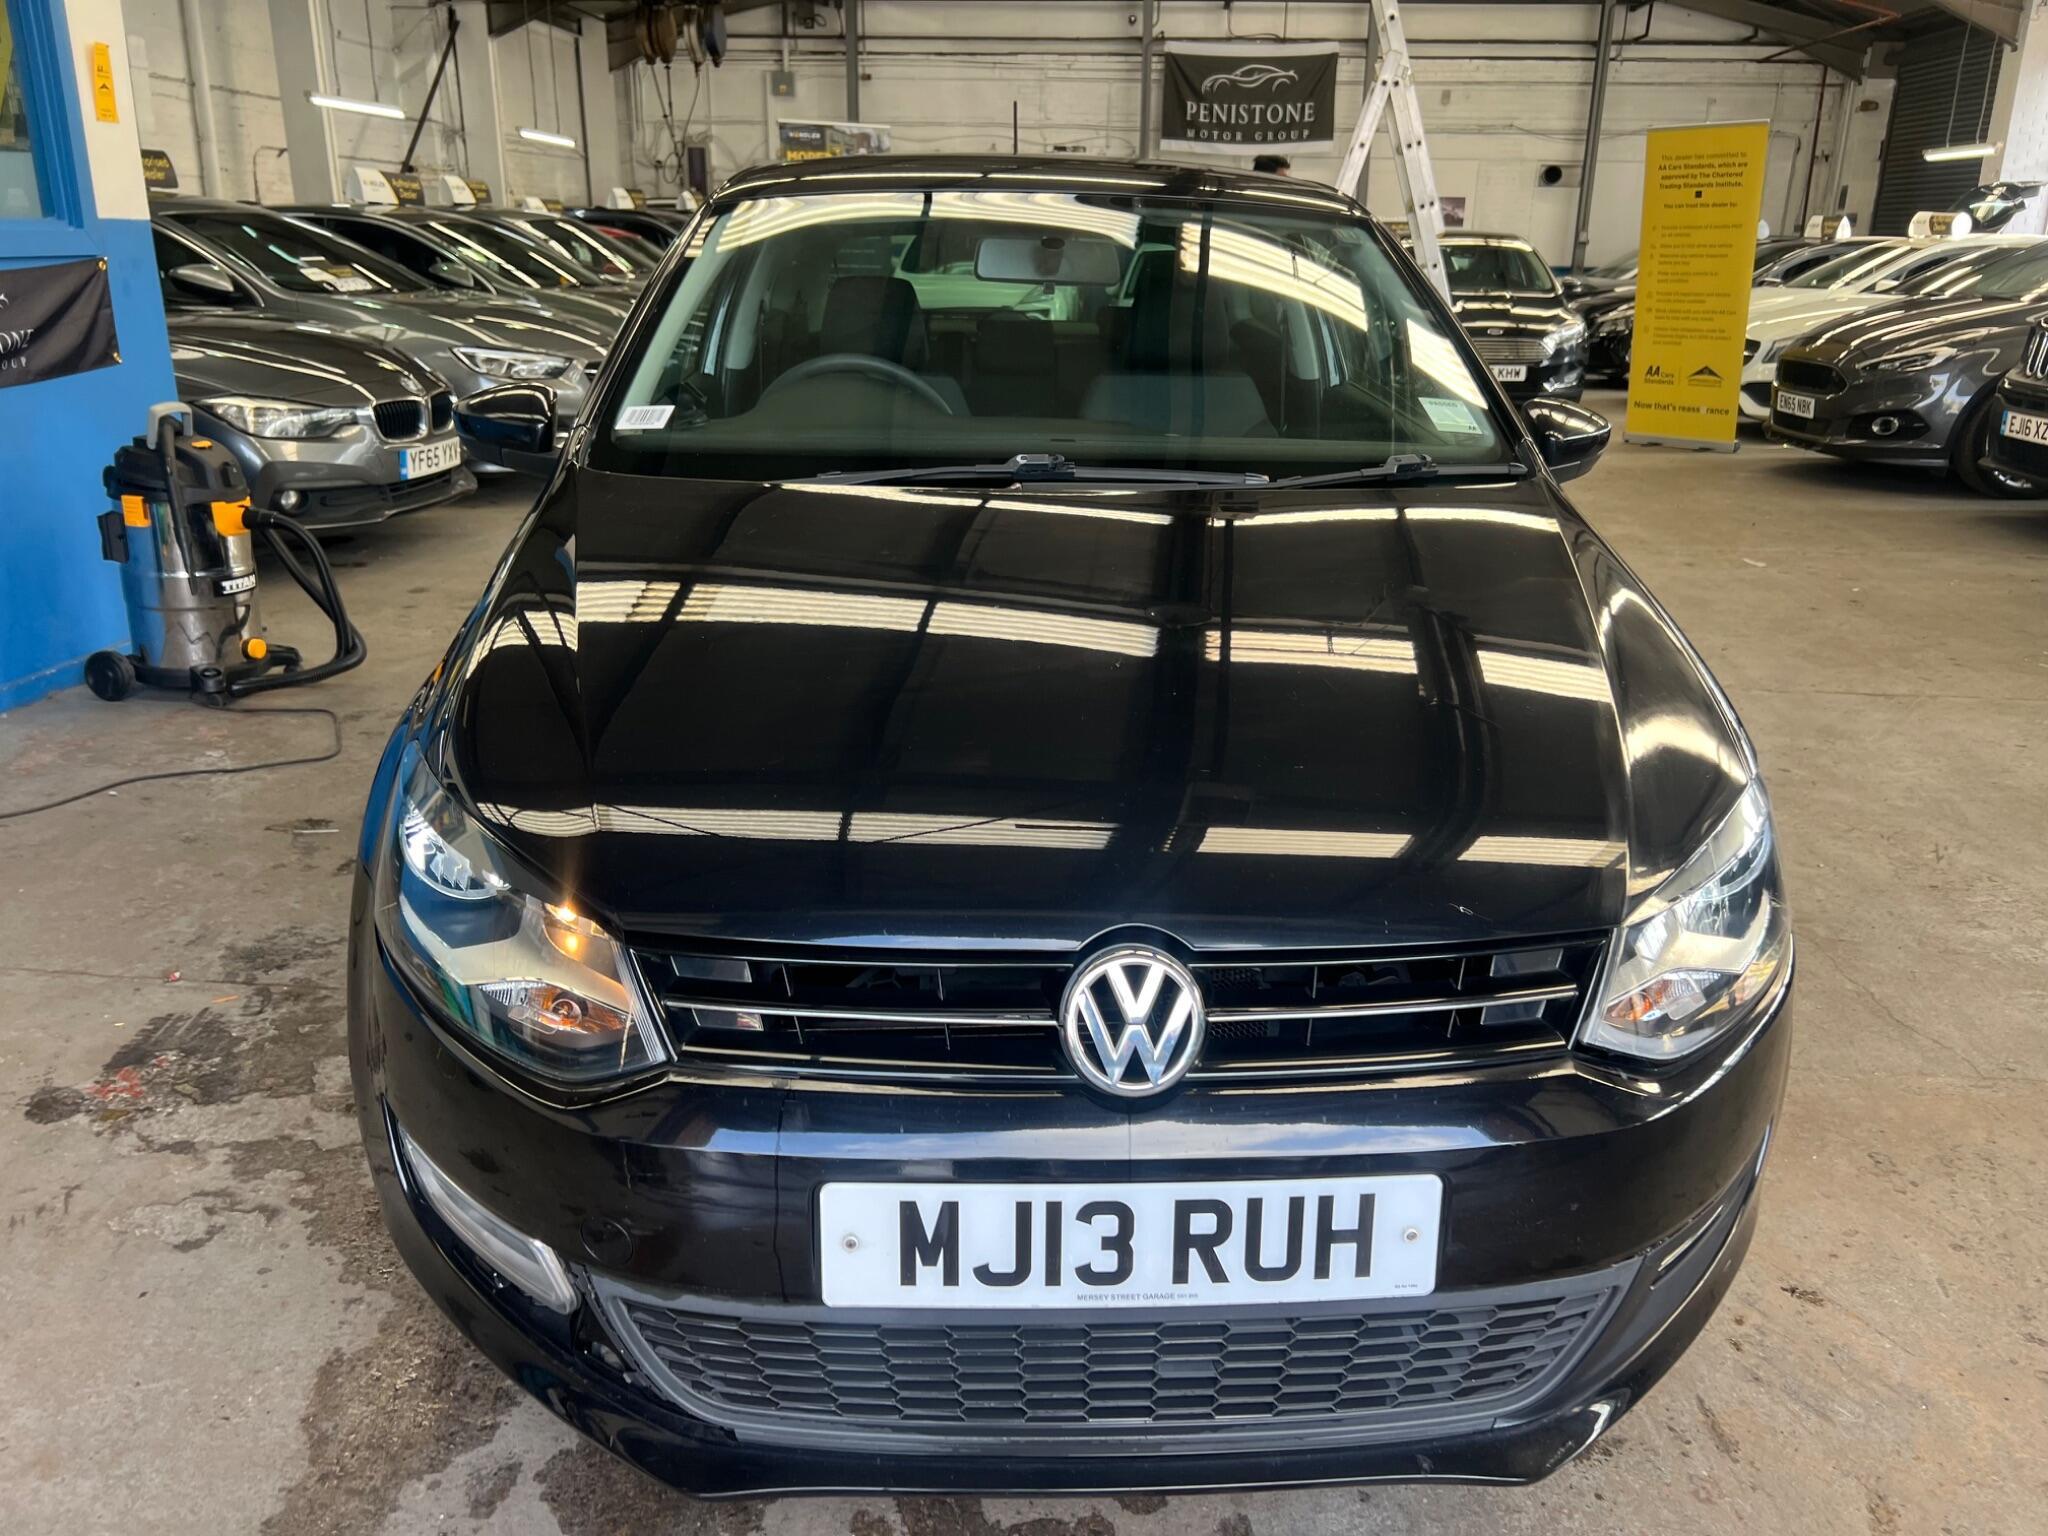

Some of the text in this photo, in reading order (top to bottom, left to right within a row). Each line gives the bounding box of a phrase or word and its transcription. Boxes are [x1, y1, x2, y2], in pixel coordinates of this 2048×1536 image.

[1186, 101, 1315, 124] PENISTONE
[1187, 129, 1310, 141] MOTOR GROUP
[1661, 173, 1689, 181] approved
[1645, 365, 1660, 378] AA
[1634, 401, 1652, 409] Now
[1654, 401, 1676, 411] that's
[1780, 394, 1812, 416] EN65 NBK
[2009, 416, 2032, 437] EJ16
[410, 446, 440, 473] YF65
[221, 574, 256, 594] TITAN
[900, 1193, 1376, 1287] MJ13 RUH
[1076, 1293, 1108, 1301] MERSEY
[1111, 1293, 1141, 1301] STREET
[1142, 1291, 1175, 1300] GARAGE
